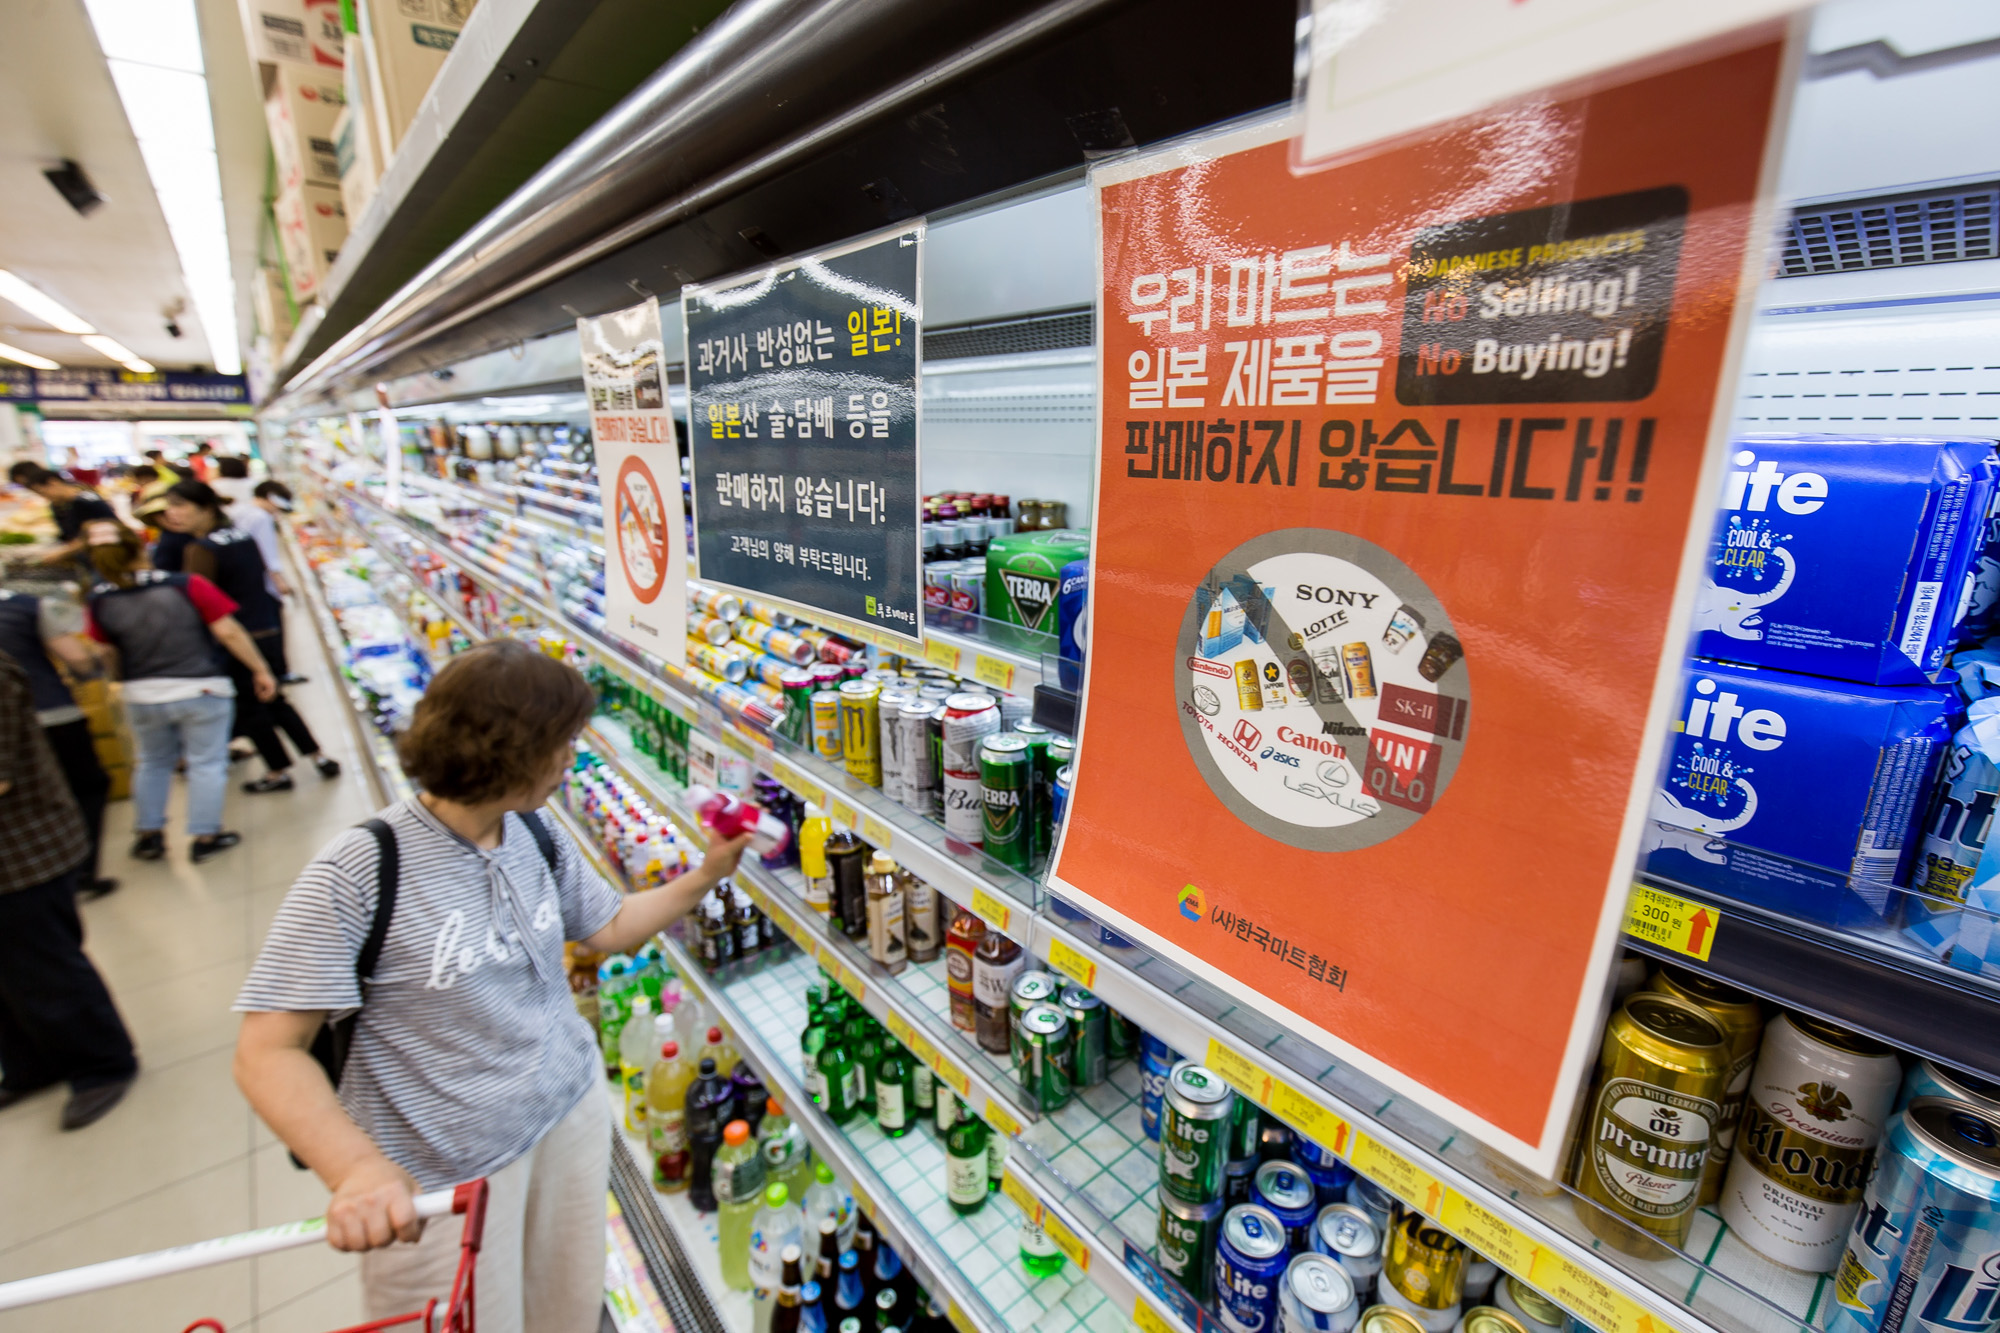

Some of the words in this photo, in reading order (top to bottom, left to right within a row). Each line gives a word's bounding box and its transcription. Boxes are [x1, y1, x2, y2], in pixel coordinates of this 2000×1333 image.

[1528, 229, 1645, 262] PRODUCTS
[1128, 264, 1211, 337] 우리
[1226, 242, 1394, 328] 마트는
[1421, 289, 1469, 325] No
[1478, 266, 1640, 321] Selling!
[697, 333, 748, 376] 과거사
[756, 319, 835, 369] 반성없는
[847, 307, 901, 357] 일본!
[1416, 342, 1460, 377] No
[1471, 329, 1631, 379] Buying!
[1127, 344, 1208, 410] 일본
[1219, 329, 1383, 408] 제품을
[708, 402, 760, 439] 일본산
[846, 391, 892, 439] 등을
[1125, 417, 1302, 486] 판매하지
[1317, 416, 1659, 503] 않습니다!!
[715, 471, 785, 513] 판매하지
[794, 476, 886, 525] 않습니다!
[730, 535, 769, 560] 고객님의
[774, 542, 795, 565] 양해
[799, 546, 872, 581] 부탁드립니다.
[1723, 548, 1766, 569] CLEAR
[1006, 575, 1052, 607] TERRA
[1296, 584, 1380, 610] SONY
[1303, 609, 1348, 638] LOTTE
[1190, 659, 1229, 676] Nintendo
[1182, 701, 1214, 733] TOYOTA
[1394, 697, 1434, 721] SK-II
[1684, 679, 1787, 751] ite
[1276, 725, 1347, 760] Canon
[1320, 721, 1367, 737] Nikon
[1217, 732, 1258, 772] HONDA
[1375, 737, 1427, 774] UNI
[1283, 775, 1378, 818] LEXUS
[1370, 767, 1425, 803] QLO
[1687, 772, 1728, 796] CLEAR
[1672, 918, 1682, 930] 원
[1211, 905, 1348, 992] (사)한국마트협회
[1622, 1083, 1643, 1096] TASTE
[1644, 1087, 1667, 1103] WITH
[1649, 1118, 1681, 1137] OB
[1767, 1102, 1865, 1147] Premium
[1626, 1171, 1678, 1193] Pilsner
[1622, 1193, 1635, 1206] ALL
[1637, 1200, 1657, 1213] MALT
[1762, 1183, 1826, 1216] ORIGINAL
[1763, 1192, 1823, 1223] GRAVITY
